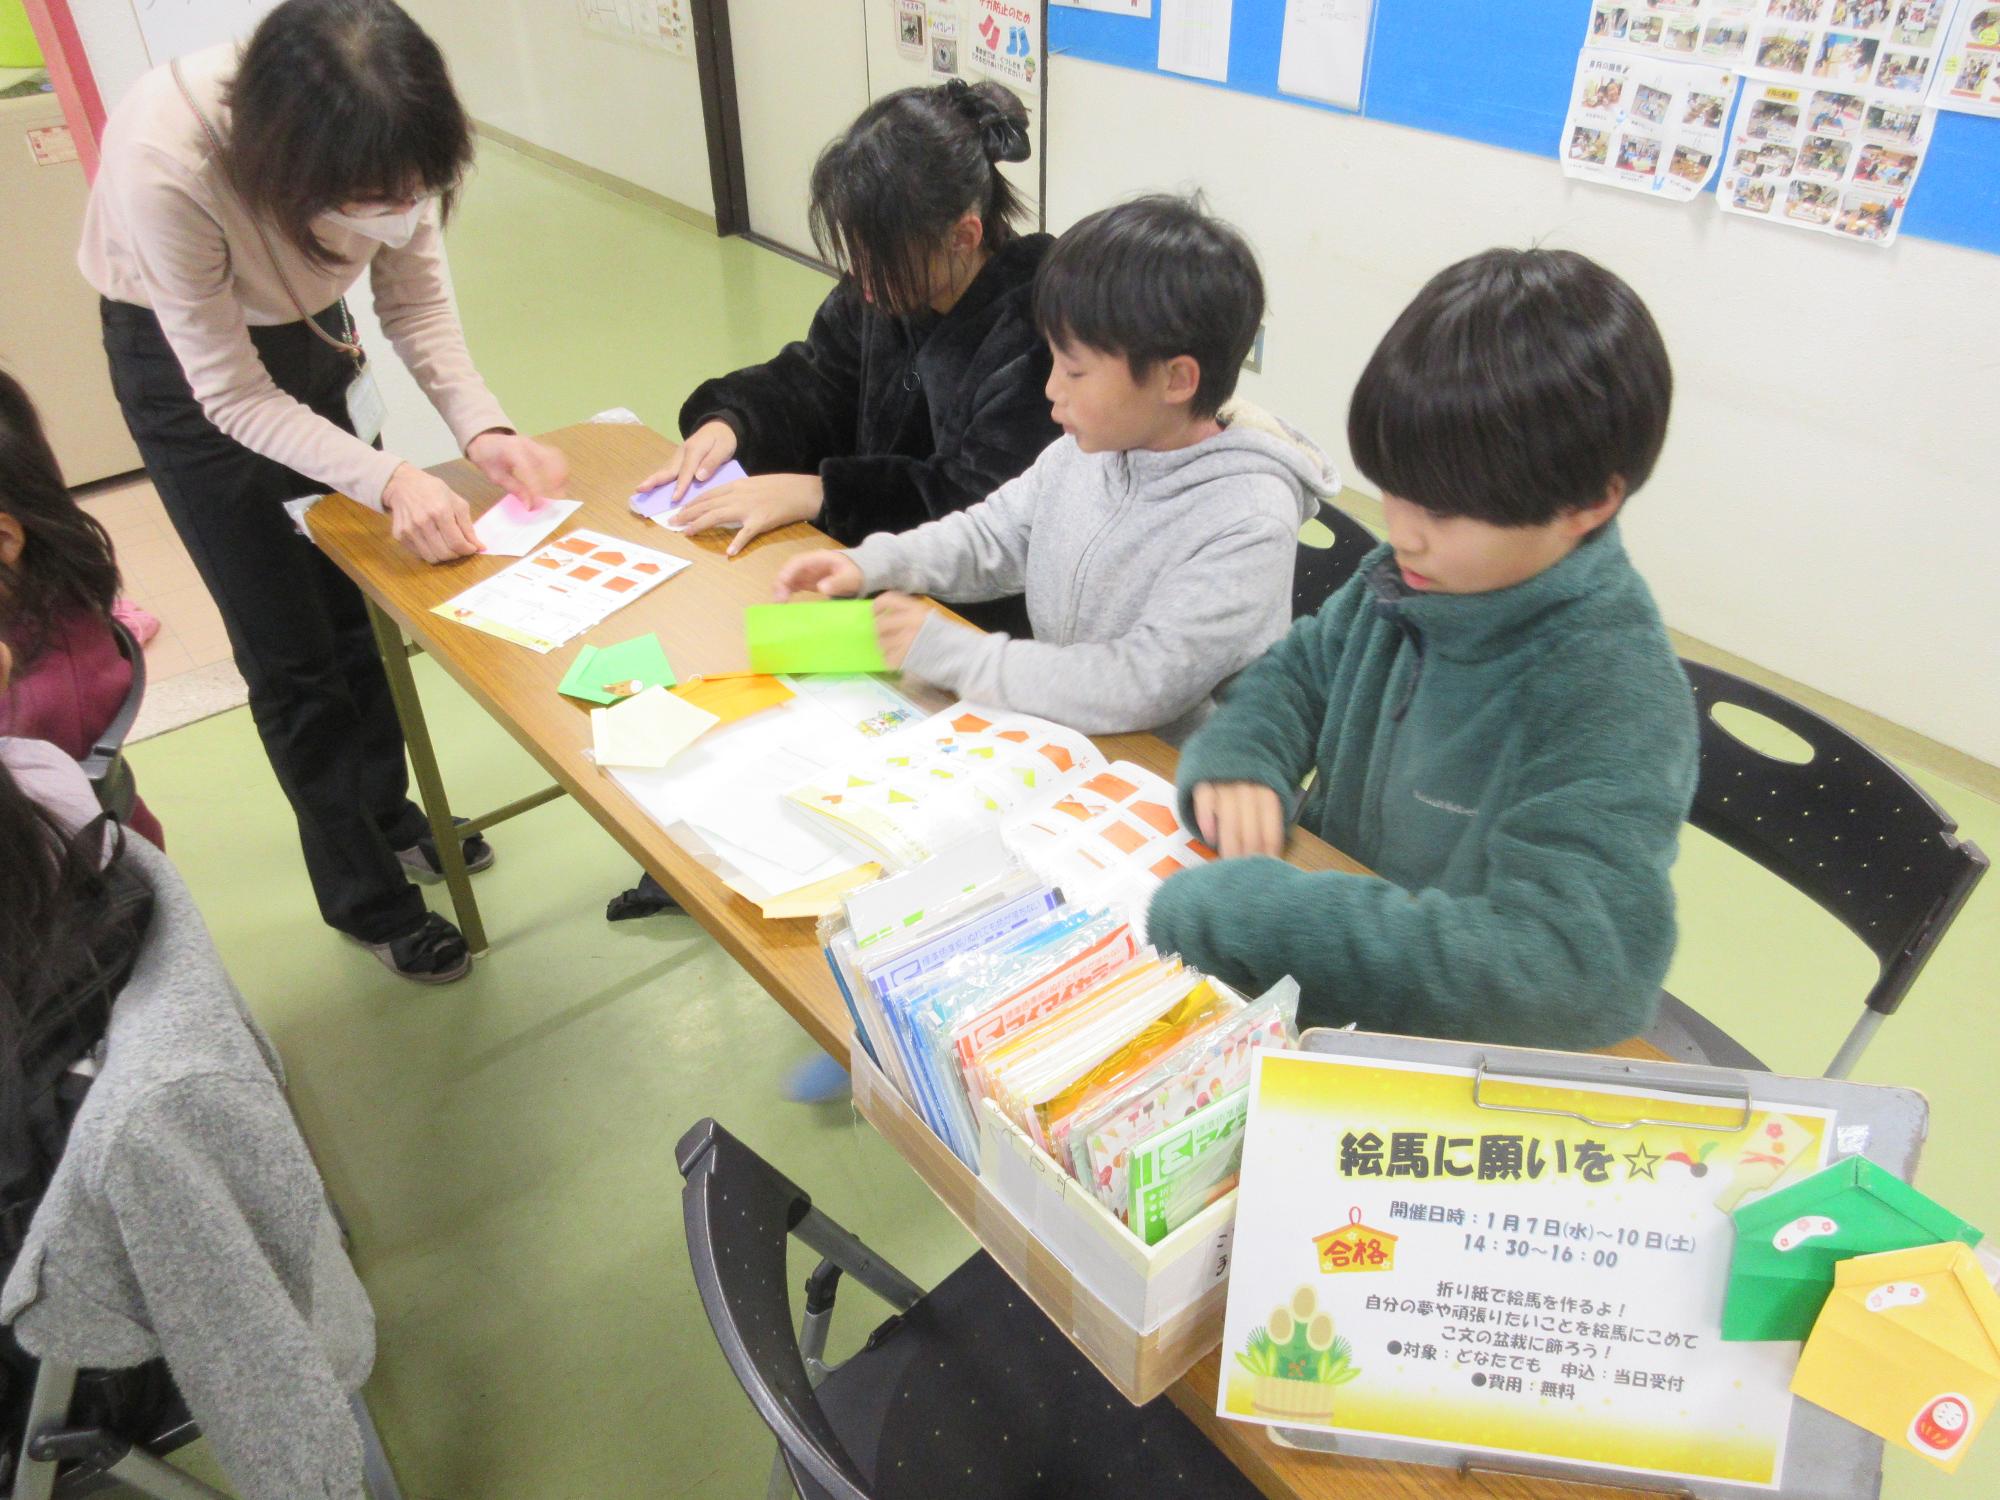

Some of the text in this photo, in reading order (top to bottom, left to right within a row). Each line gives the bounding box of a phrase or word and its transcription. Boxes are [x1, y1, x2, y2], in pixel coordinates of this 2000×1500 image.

[1323, 1238, 1389, 1267] 合格
[1436, 1280, 1627, 1317] 折り紙で絵馬を作るよ！
[1365, 1294, 1699, 1349] 自分の夢や頑張りたいことを絵馬にこめて
[1441, 1325, 1612, 1359] こ文の盆栽に飾ろう！
[1560, 1362, 1686, 1393] 申込：当日受付
